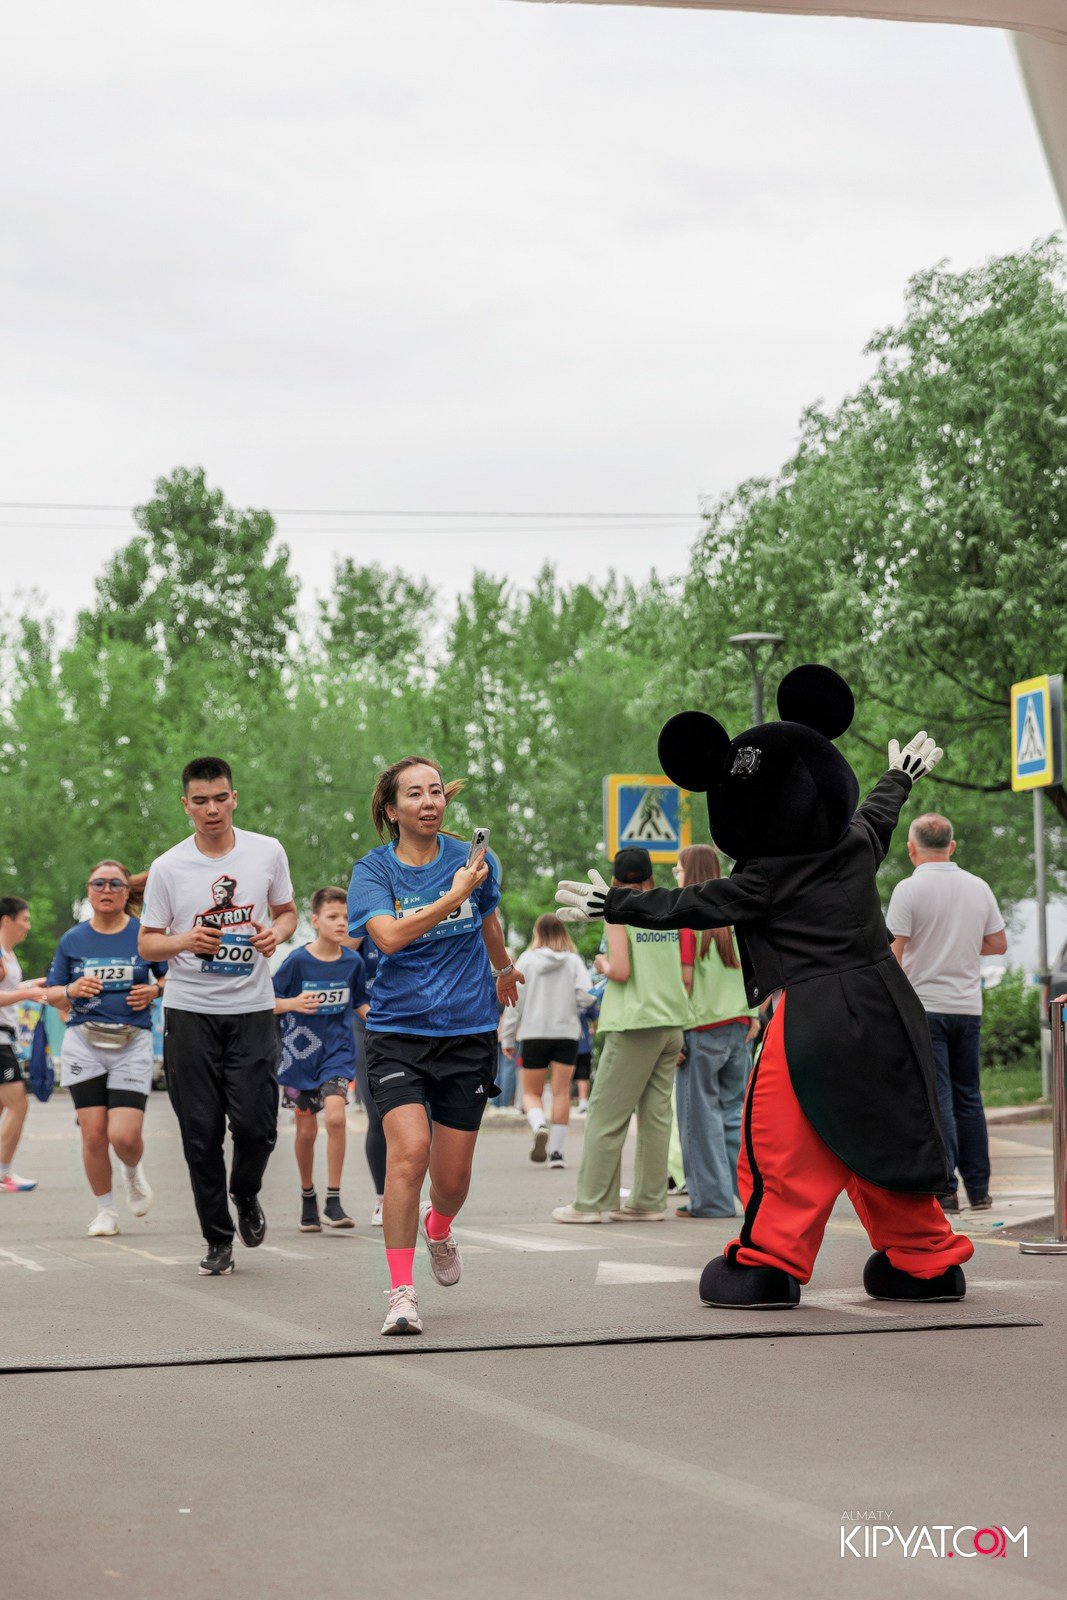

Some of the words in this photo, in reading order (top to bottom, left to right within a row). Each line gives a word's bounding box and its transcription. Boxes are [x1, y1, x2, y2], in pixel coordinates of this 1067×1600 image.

[215, 945, 253, 962] 000
[93, 967, 125, 980] 1123
[311, 990, 344, 1004] 051
